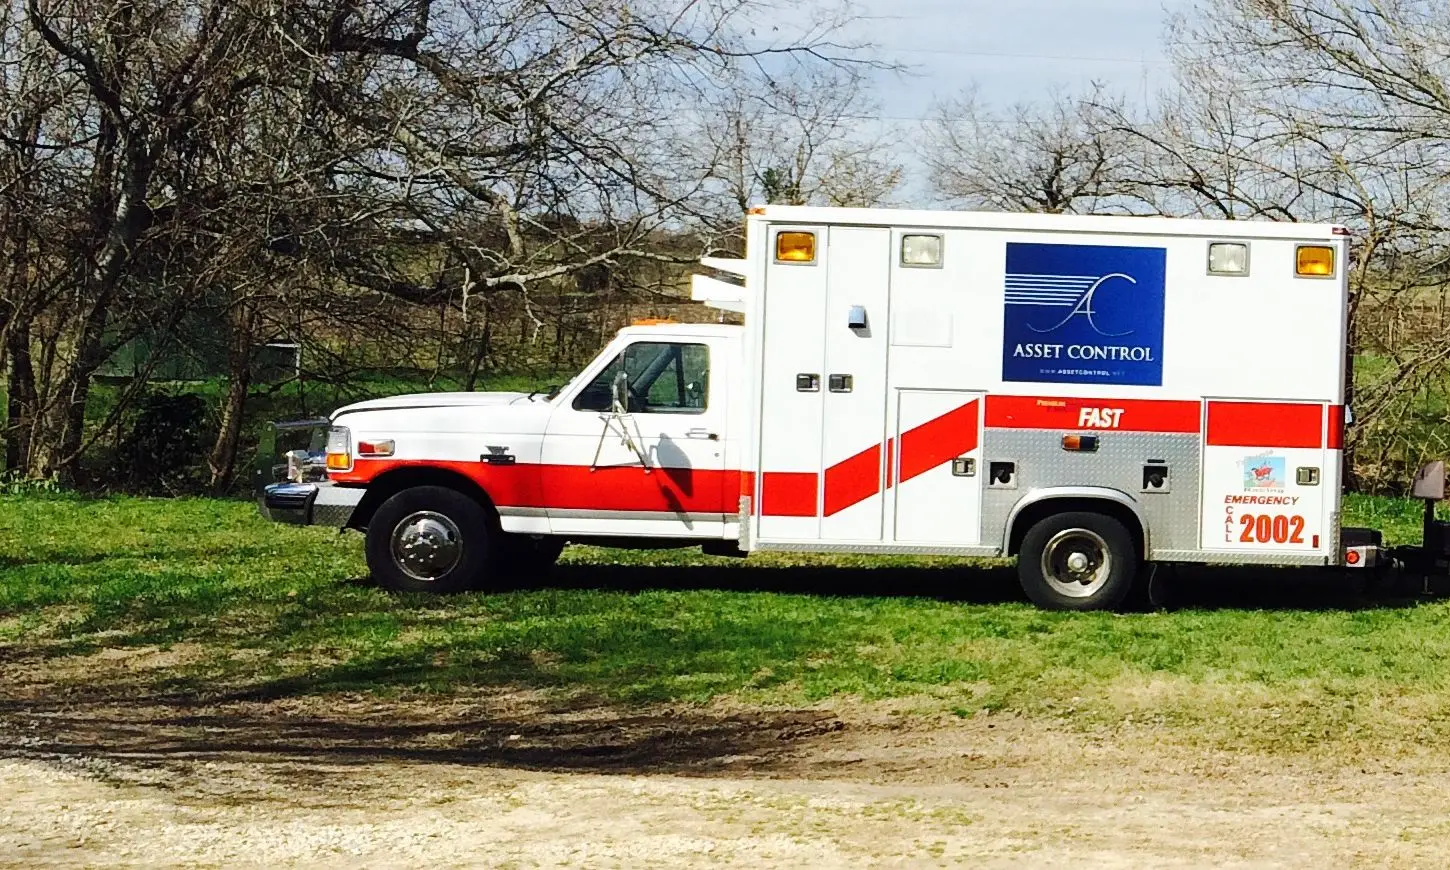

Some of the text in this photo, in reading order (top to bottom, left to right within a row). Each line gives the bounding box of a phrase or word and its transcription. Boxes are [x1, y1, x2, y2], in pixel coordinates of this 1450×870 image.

[1013, 343, 1154, 362] ASSET CONTROL
[1078, 407, 1125, 428] FAST
[1224, 494, 1300, 506] EMERGENCY
[1224, 505, 1234, 543] CALL
[1239, 513, 1305, 544] 2002
